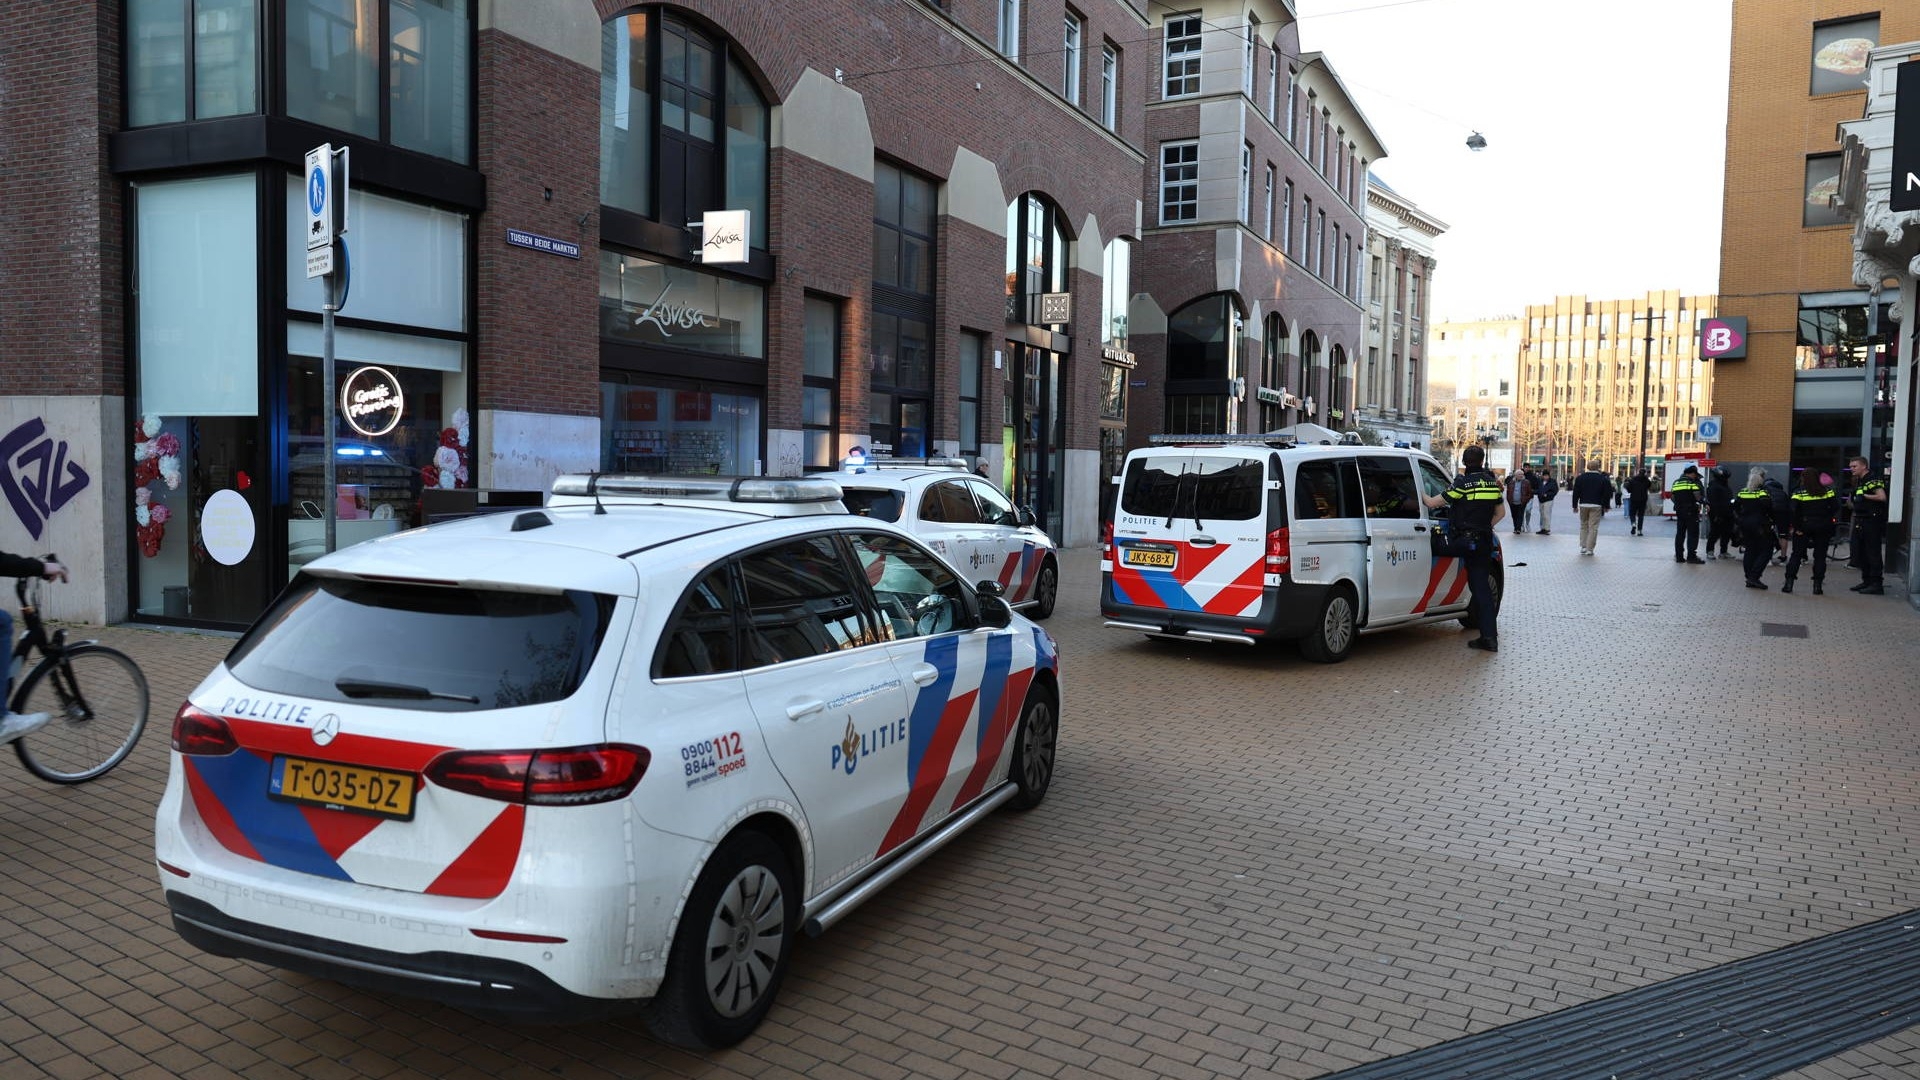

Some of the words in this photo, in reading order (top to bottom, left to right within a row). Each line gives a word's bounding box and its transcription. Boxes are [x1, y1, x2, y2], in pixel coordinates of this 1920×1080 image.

[510, 232, 533, 246] TUSSEN
[534, 237, 551, 250] BEIDE
[552, 242, 578, 256] MARKTEN
[704, 226, 742, 249] Lovisa
[635, 280, 712, 338] Lovisa
[354, 383, 390, 404] Gratis
[349, 396, 400, 418] Piercing
[1122, 516, 1158, 526] POLITIE
[969, 553, 995, 570] POLITIE
[1130, 551, 1170, 564] JKX-68-X
[1386, 550, 1417, 566] POLITIE
[221, 696, 312, 723] POLITIE
[681, 740, 713, 761] 0900
[713, 732, 744, 760] 112
[832, 717, 906, 775] POLITIE
[685, 756, 716, 776] 8844
[718, 754, 746, 777] spoed
[291, 764, 402, 808] T-035-DZ
